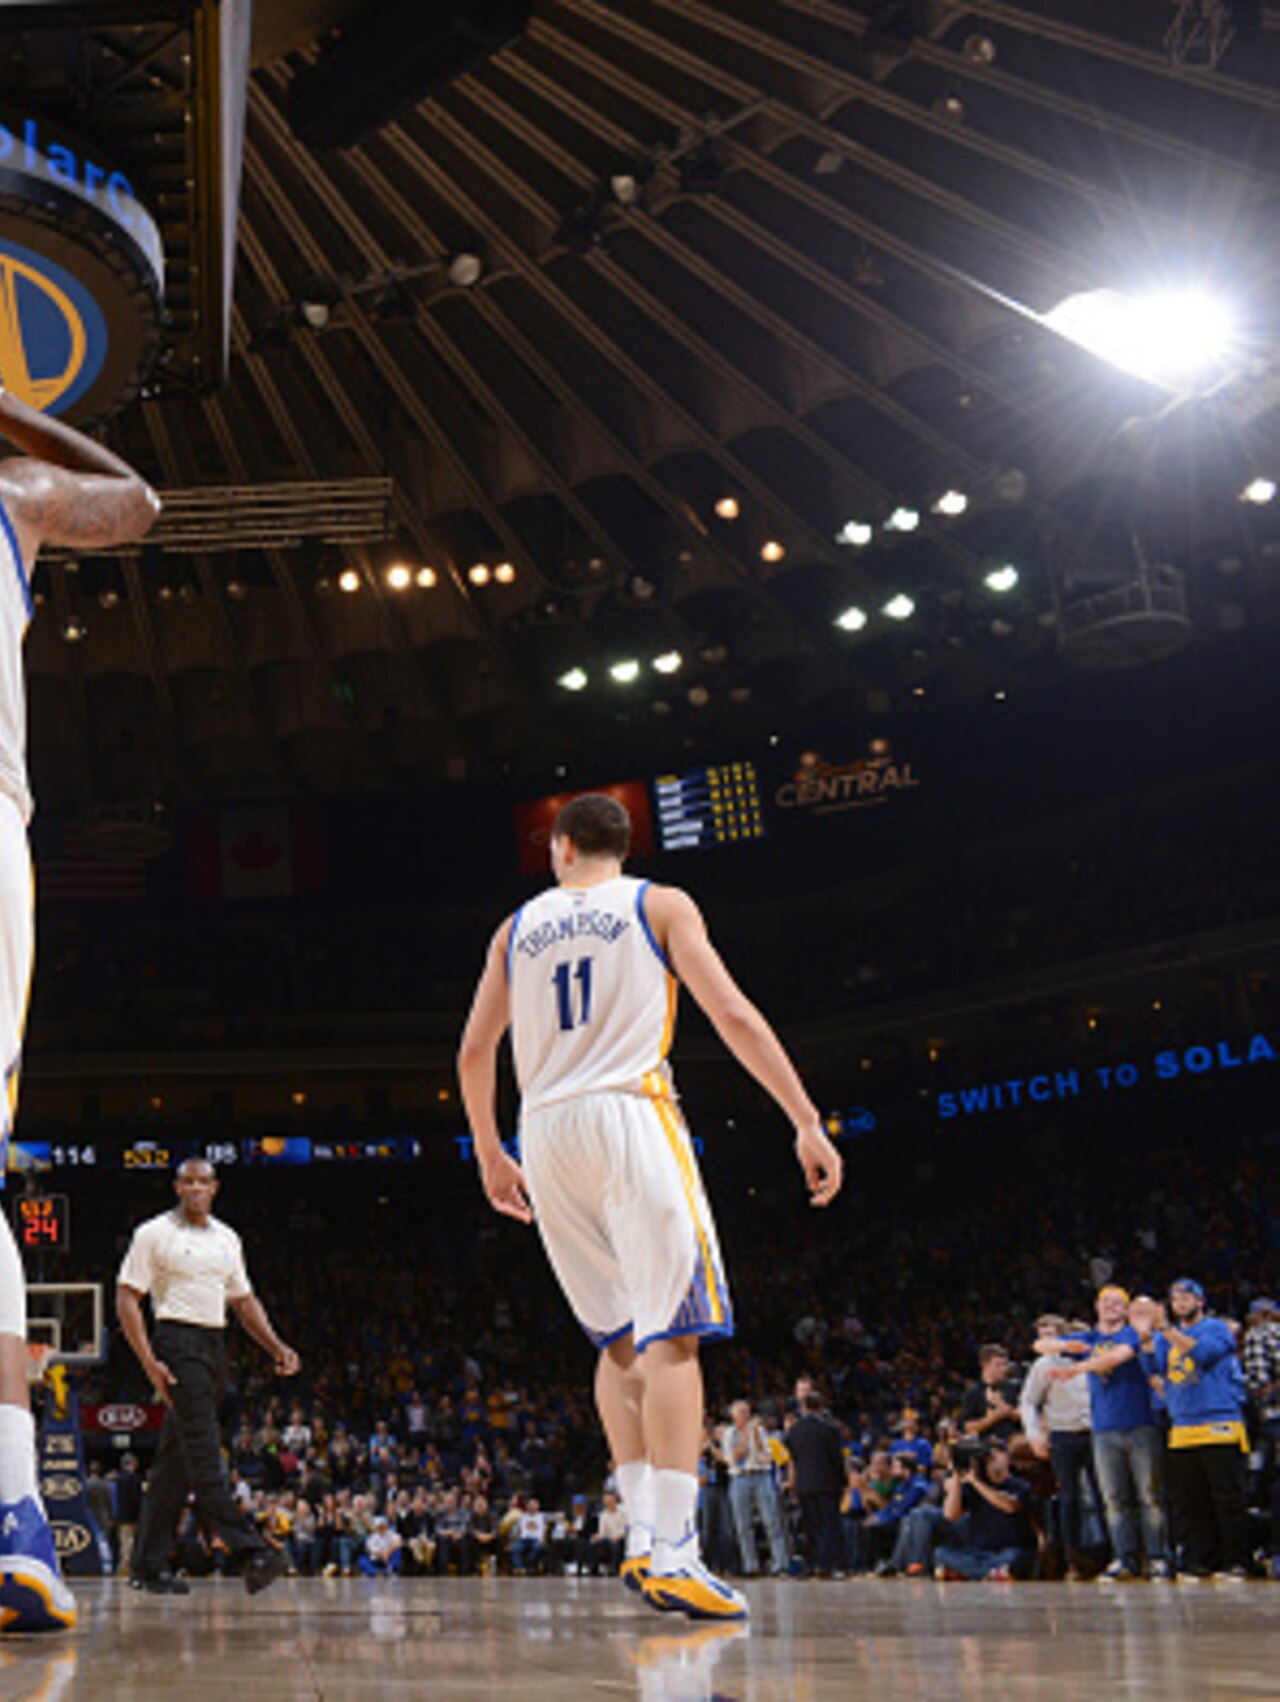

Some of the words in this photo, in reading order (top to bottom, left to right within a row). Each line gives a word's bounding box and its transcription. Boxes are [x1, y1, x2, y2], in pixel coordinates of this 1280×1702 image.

[774, 761, 923, 809] CENTRAL
[517, 909, 630, 958] THOMPSON
[551, 956, 593, 1031] 11
[938, 1069, 1089, 1119] SWITCH
[1095, 1063, 1139, 1088] TO
[24, 1218, 58, 1244] 24
